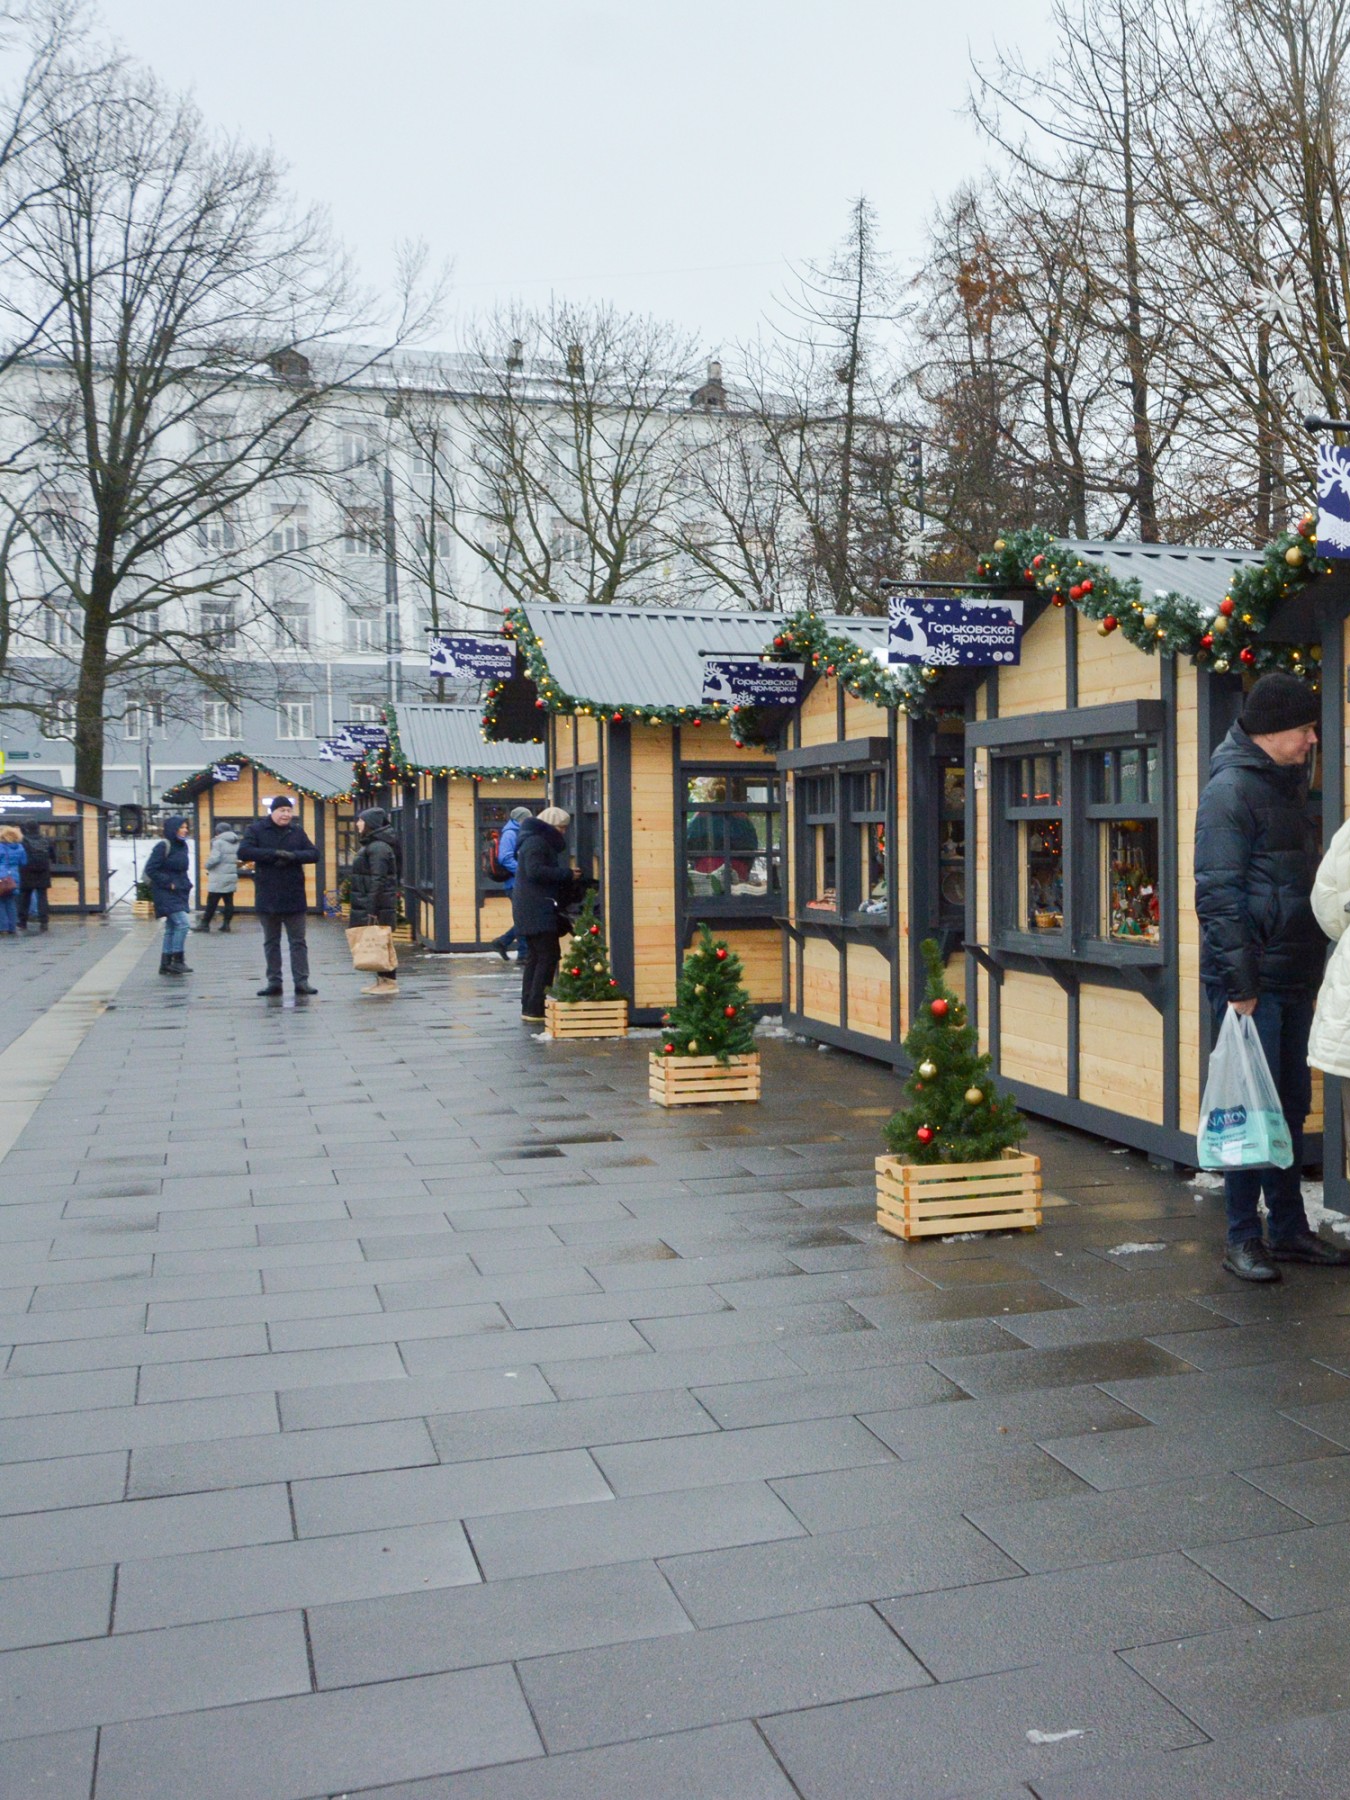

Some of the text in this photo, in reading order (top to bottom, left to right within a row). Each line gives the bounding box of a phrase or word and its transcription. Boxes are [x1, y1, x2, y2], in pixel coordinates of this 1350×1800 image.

[928, 621, 1015, 636] Горьковская
[952, 634, 1015, 646] ярмарка
[732, 677, 798, 687] Горьковская
[750, 685, 797, 693] ярмарка
